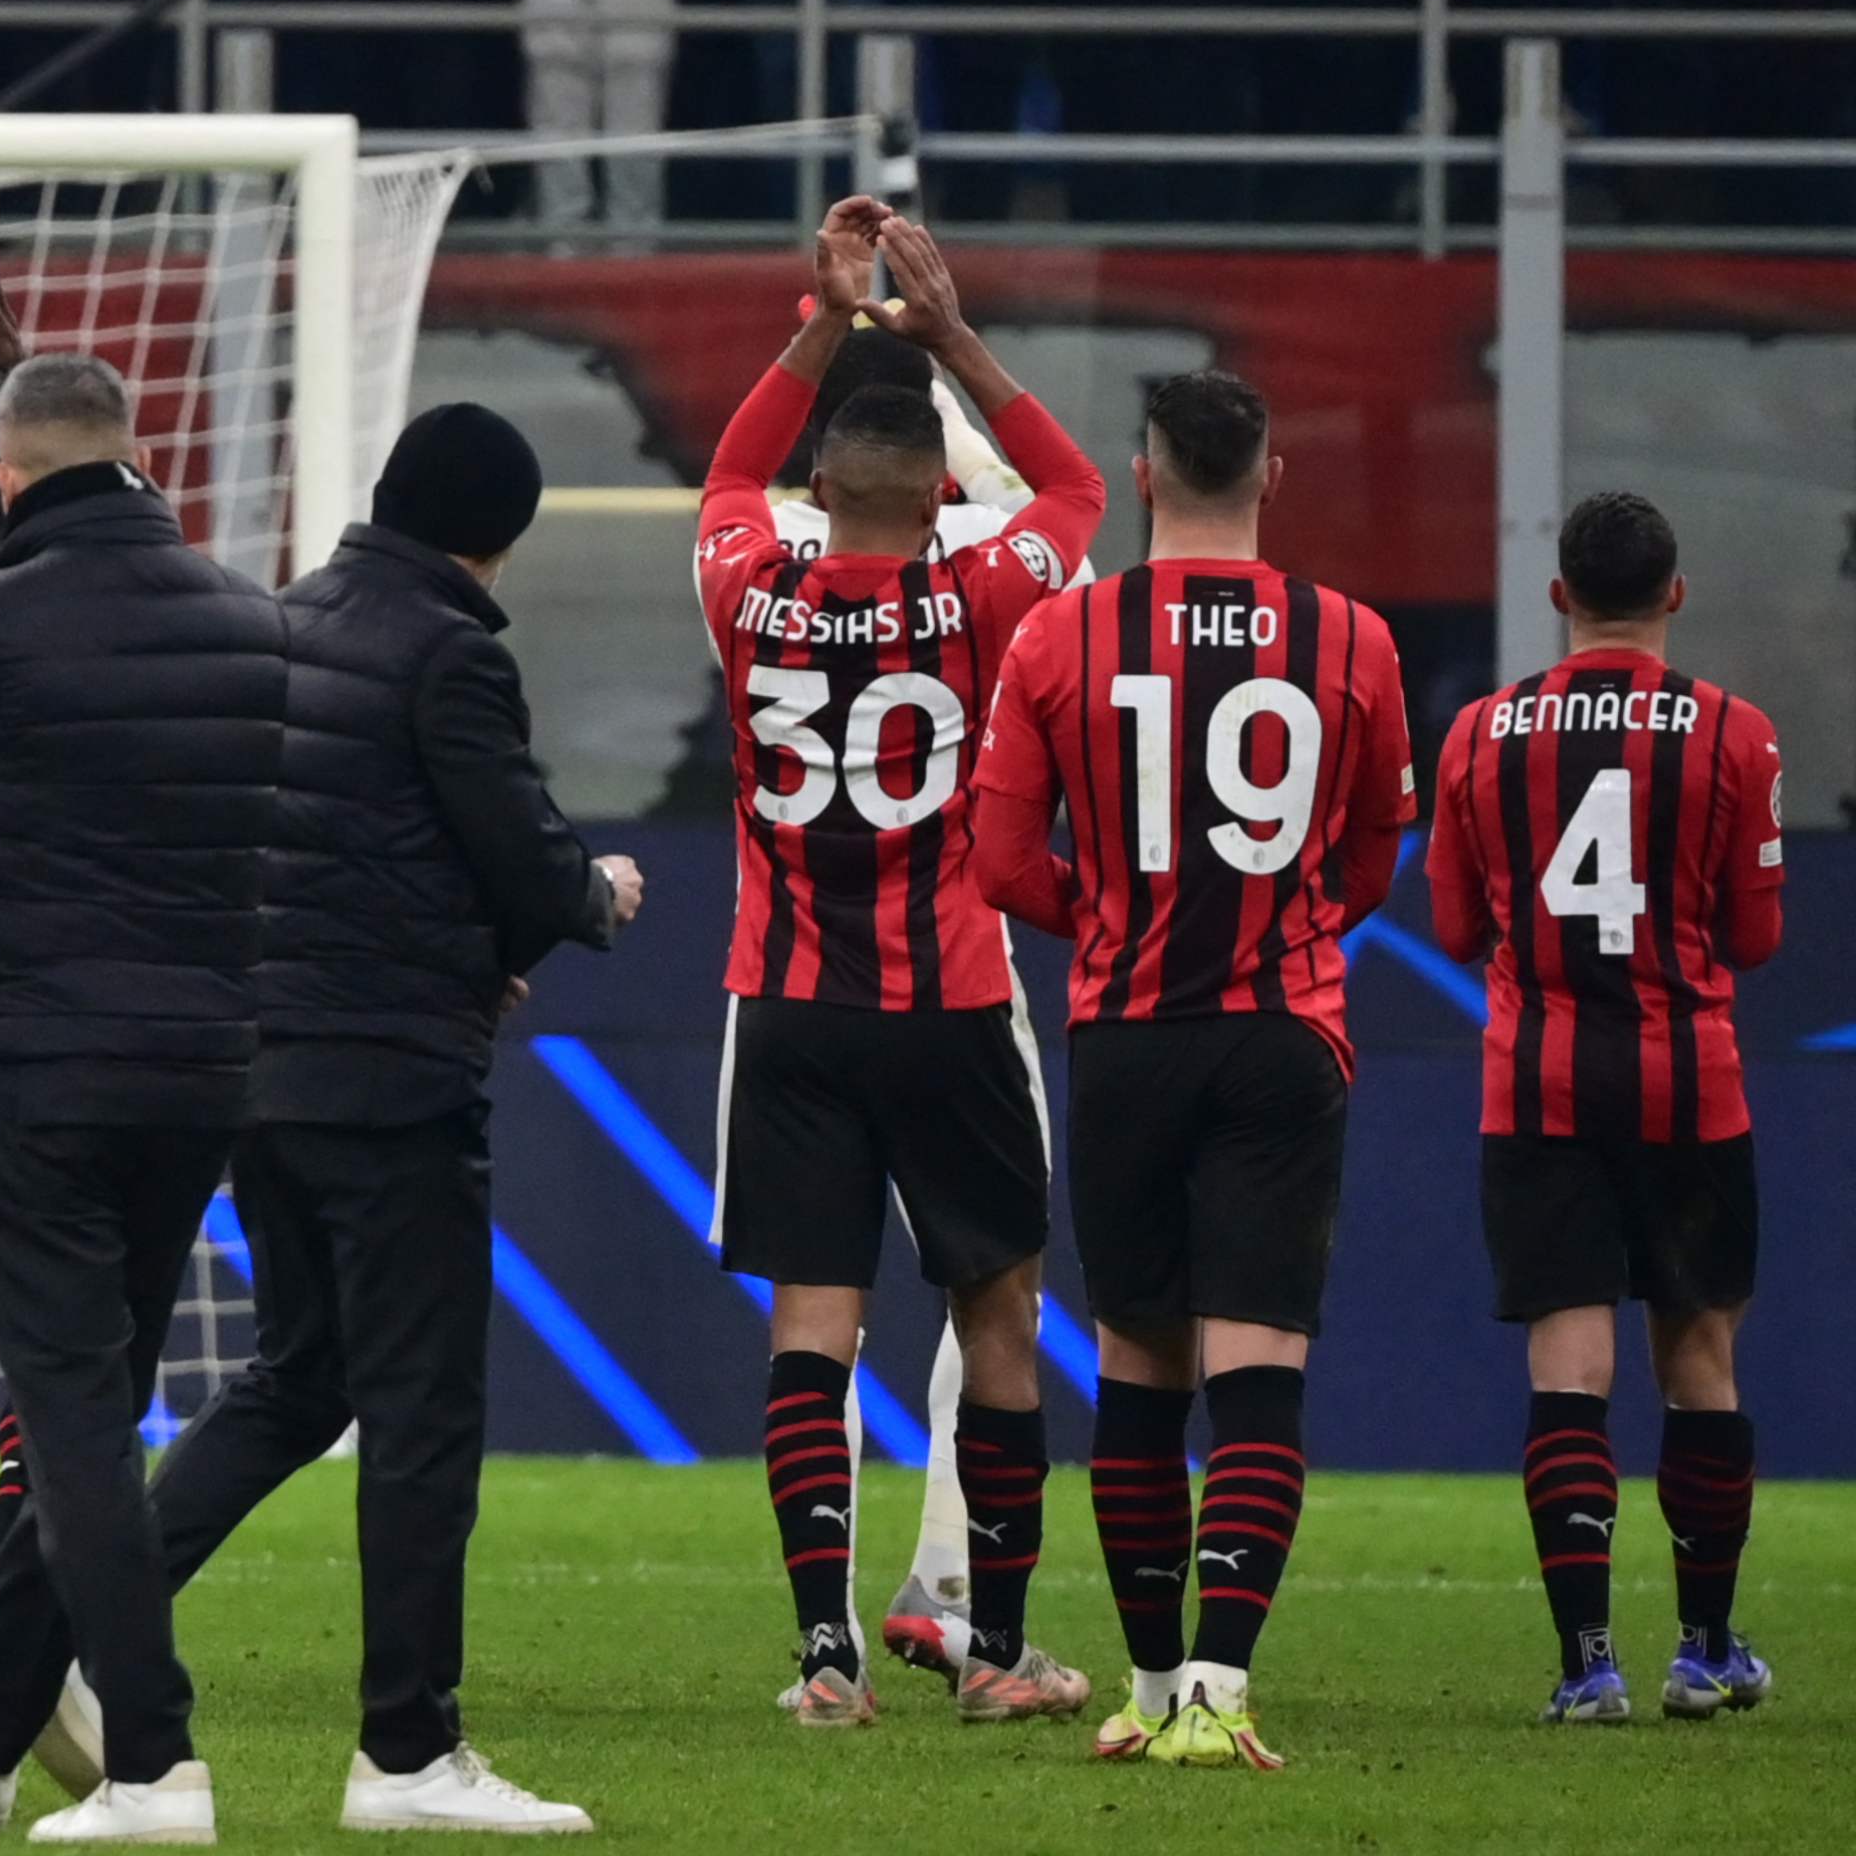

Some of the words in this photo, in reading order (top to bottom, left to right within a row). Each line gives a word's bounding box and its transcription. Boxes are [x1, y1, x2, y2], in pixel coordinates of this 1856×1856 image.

[735, 586, 900, 643] MESSIAS
[915, 592, 961, 639] JR
[1165, 604, 1277, 647] THEO
[747, 665, 965, 830] 30
[1490, 691, 1699, 739] BENNACER
[1110, 674, 1322, 875] 19
[1540, 769, 1645, 954] 4
